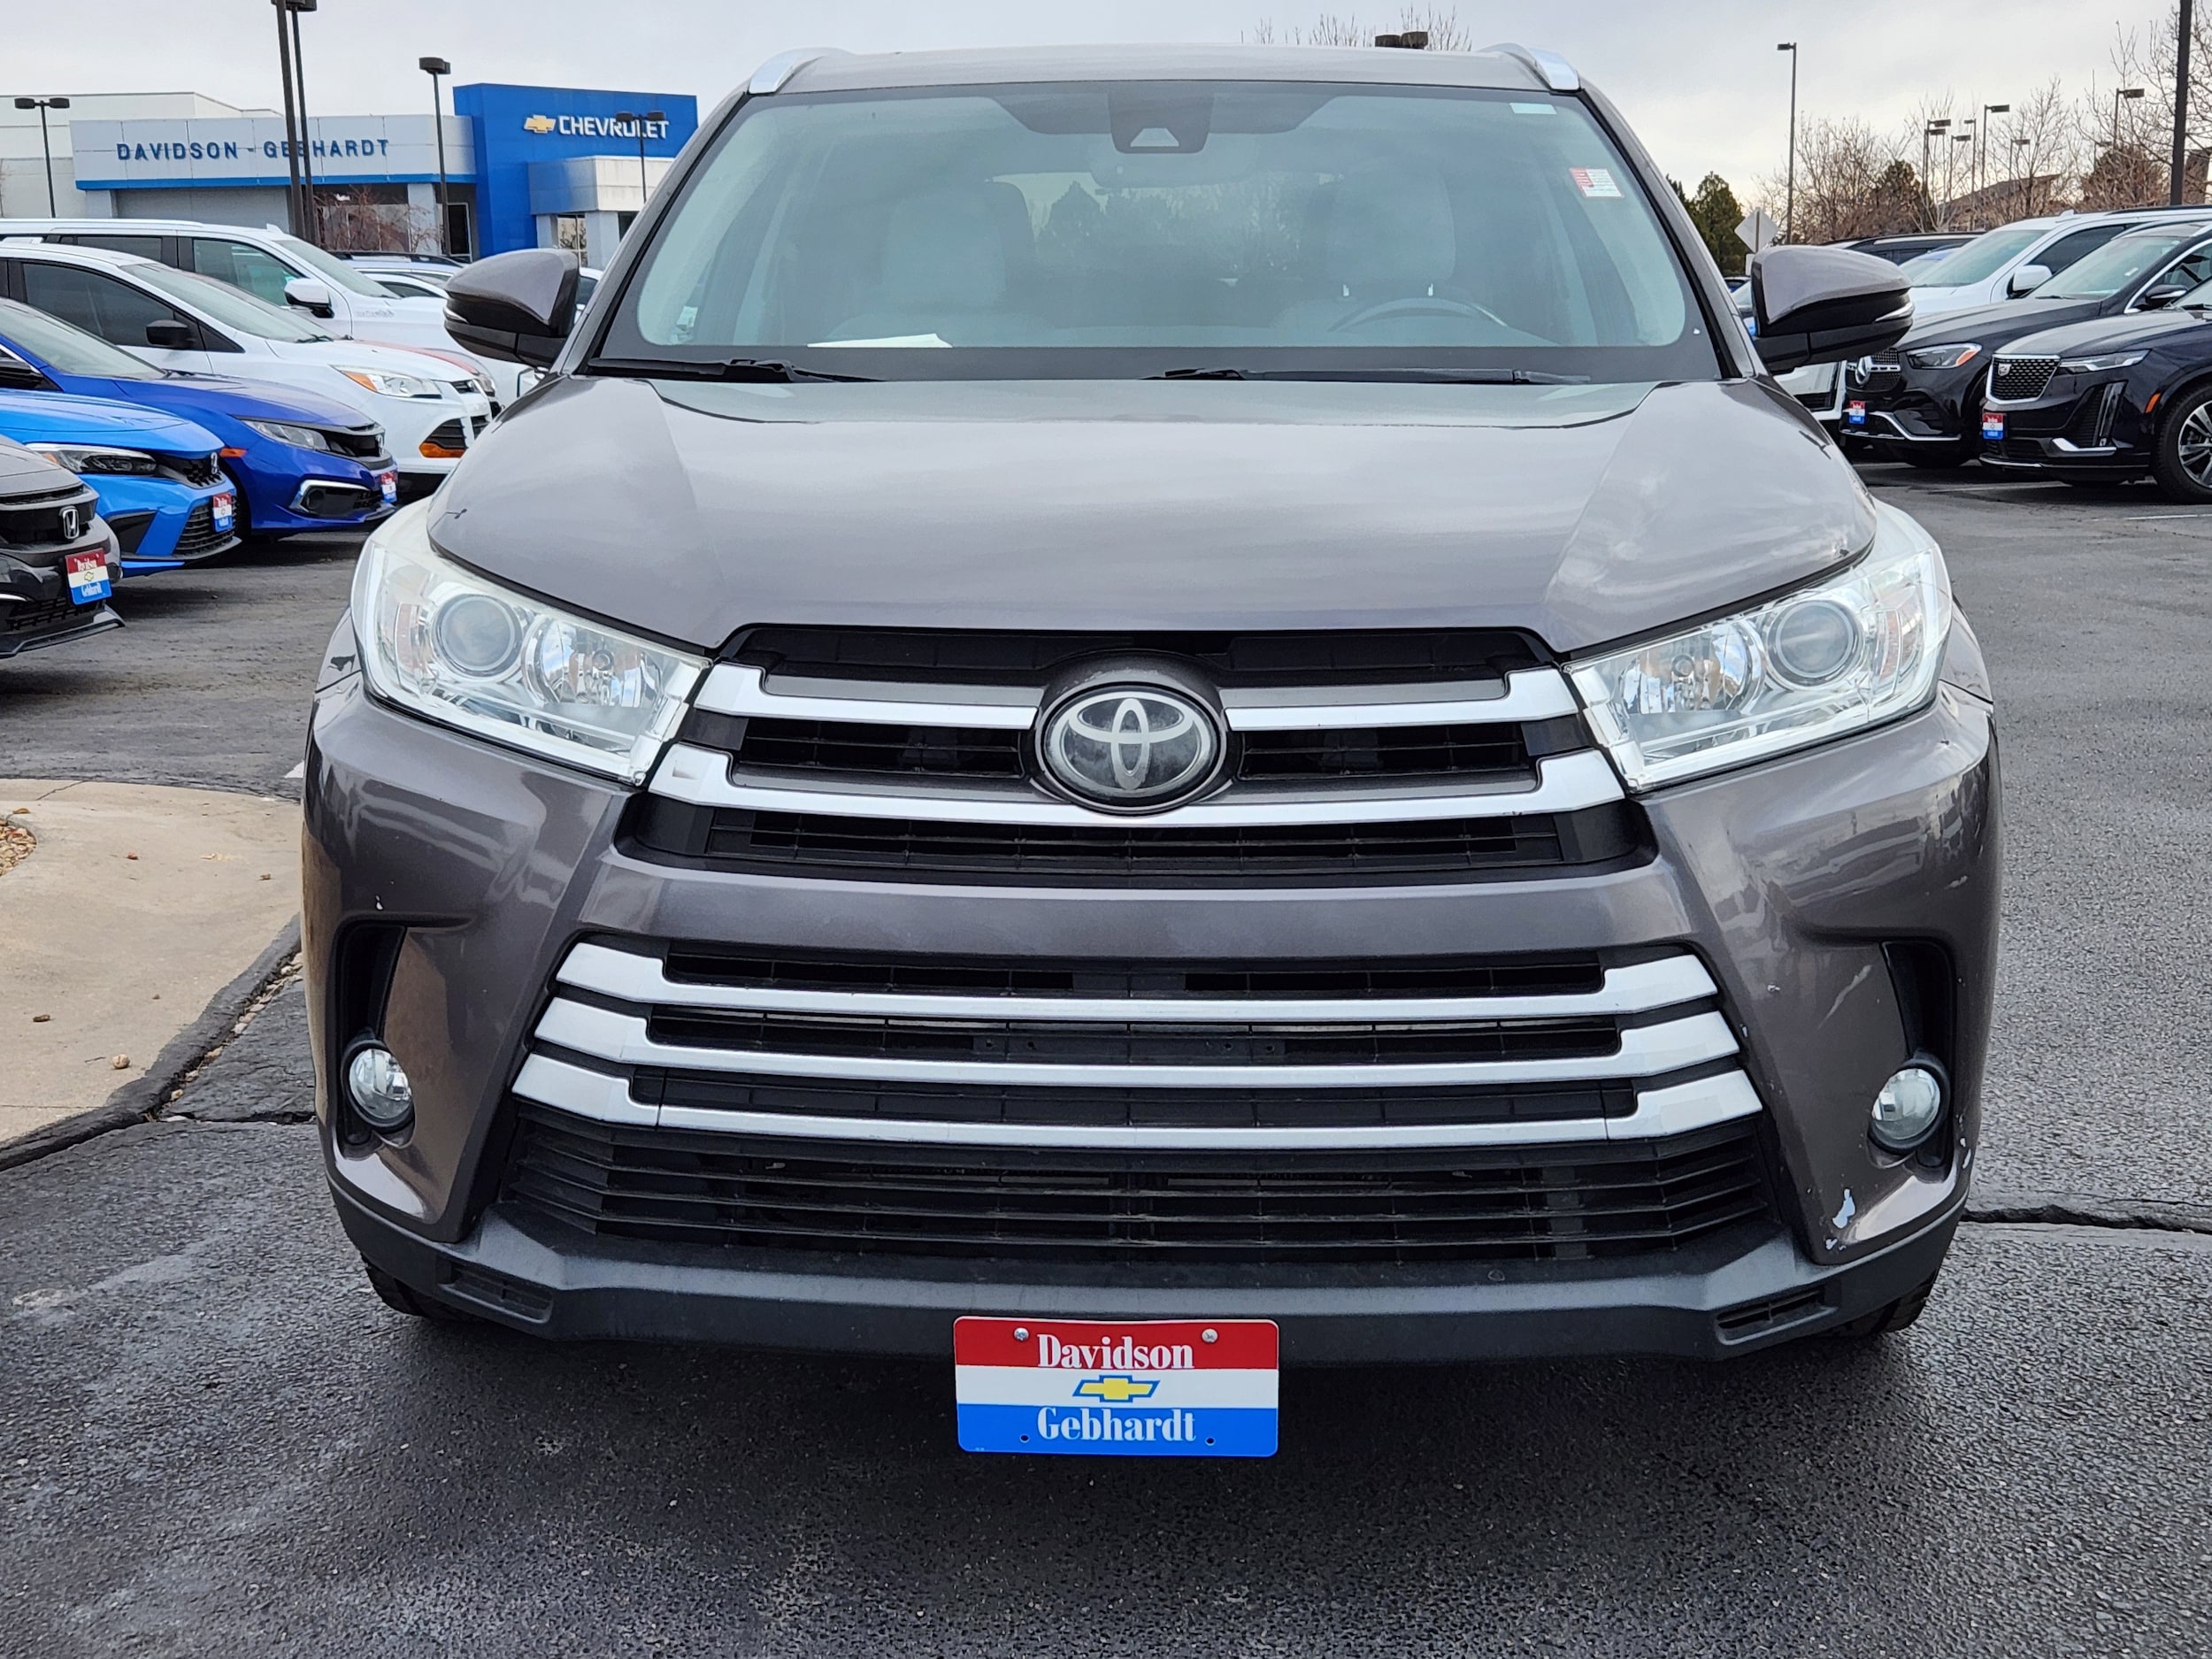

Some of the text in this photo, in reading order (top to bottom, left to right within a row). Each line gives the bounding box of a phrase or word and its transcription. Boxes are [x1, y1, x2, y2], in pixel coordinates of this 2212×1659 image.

[558, 115, 670, 139] CHEVROLET
[117, 142, 238, 161] DAVIDSON
[1037, 1333, 1195, 1370] Davidson
[1037, 1406, 1196, 1442] Gebhardt
